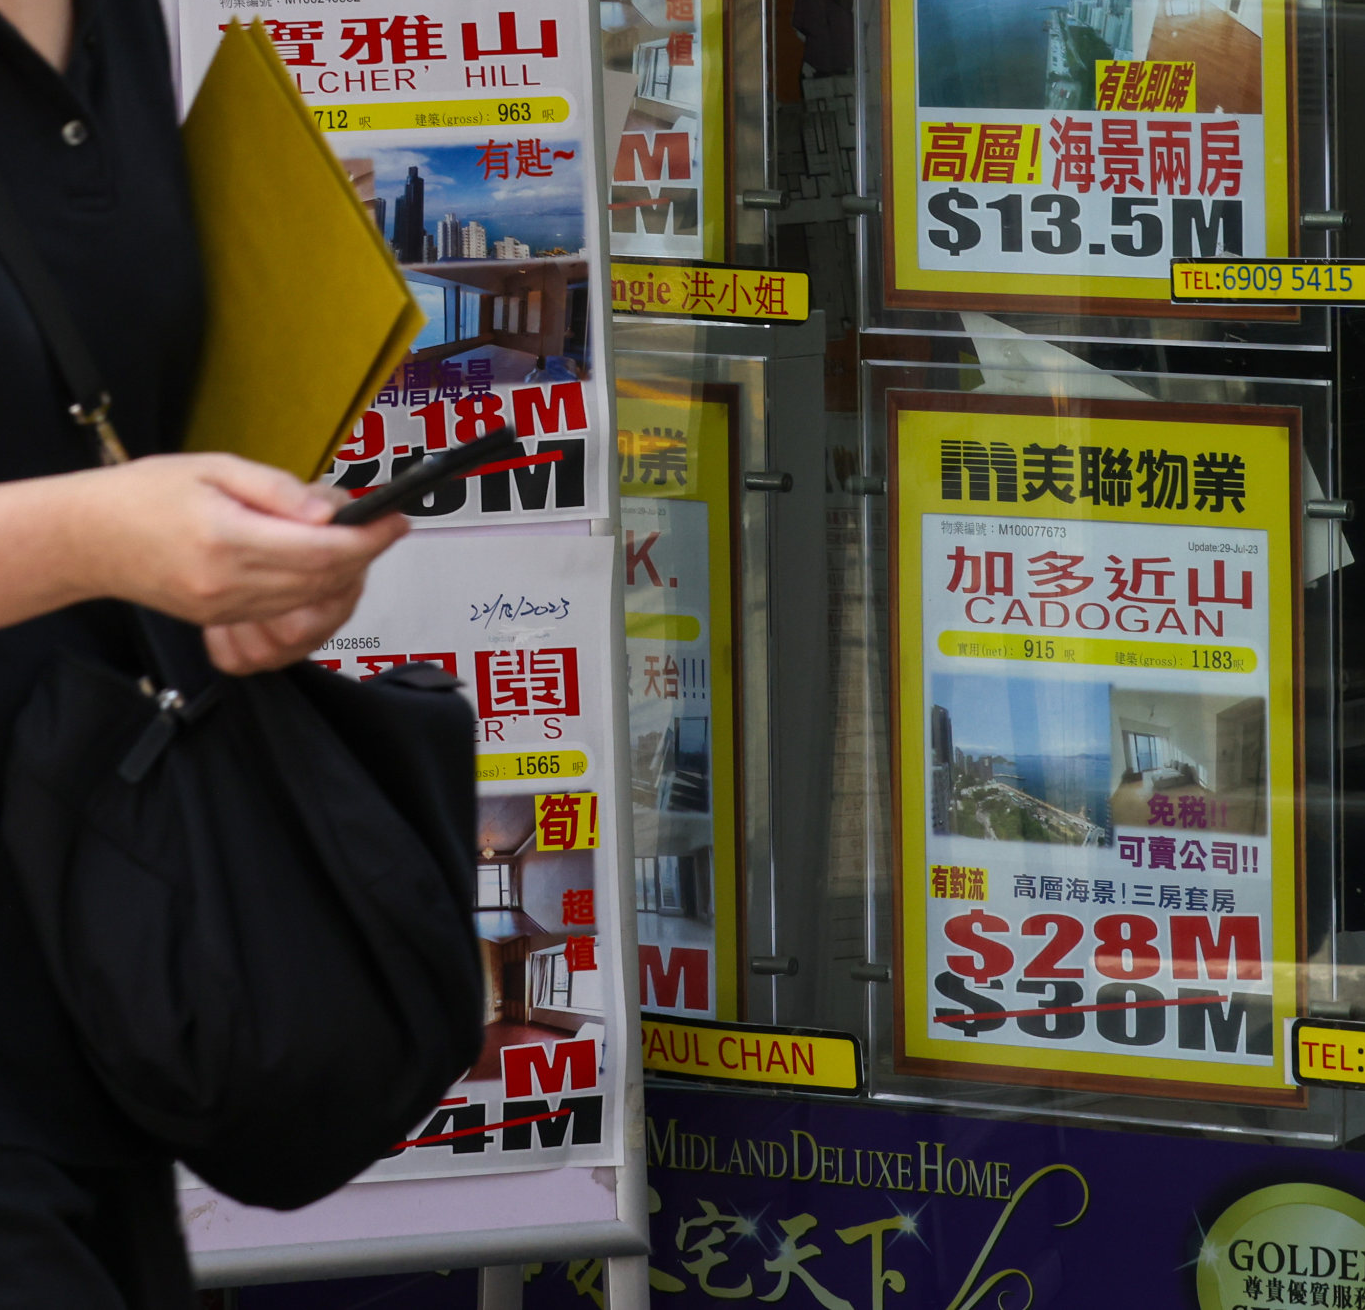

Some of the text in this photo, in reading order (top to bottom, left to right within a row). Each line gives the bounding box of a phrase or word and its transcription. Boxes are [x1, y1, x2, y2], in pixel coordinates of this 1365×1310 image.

[465, 64, 541, 88] HILL
[1097, 61, 1195, 112] 有匙即睇
[498, 104, 531, 123] 963
[928, 188, 1243, 257] $13.5M
[947, 546, 1253, 609] 加多近山
[965, 597, 1224, 637] CADOGAN
[1024, 640, 1232, 670] 915 1183
[515, 756, 561, 778] 1565
[931, 865, 985, 900] 有對流
[944, 909, 1263, 984] $28M
[934, 971, 1273, 1056] $30M
[718, 1037, 815, 1077] CHAN
